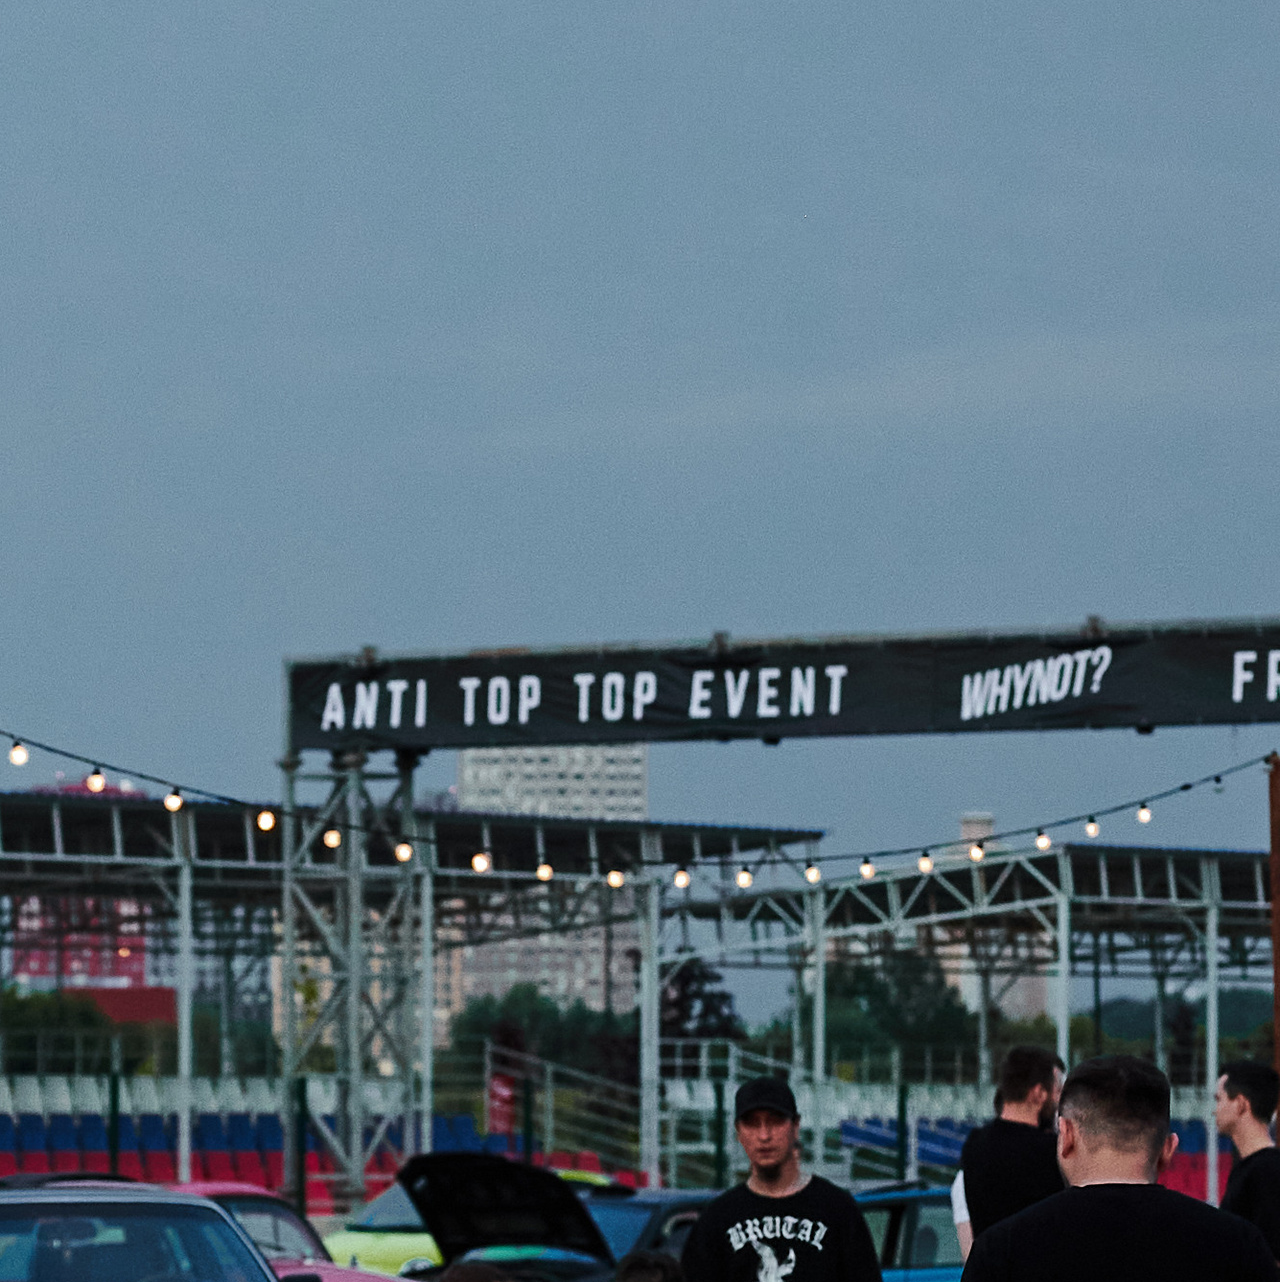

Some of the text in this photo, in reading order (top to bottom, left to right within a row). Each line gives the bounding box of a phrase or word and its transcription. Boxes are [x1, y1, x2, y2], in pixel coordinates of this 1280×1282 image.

[320, 665, 848, 731] ANTI TOP TOP EVENT
[960, 646, 1112, 720] WHYNOT?
[727, 1216, 828, 1251] BRUTAL
